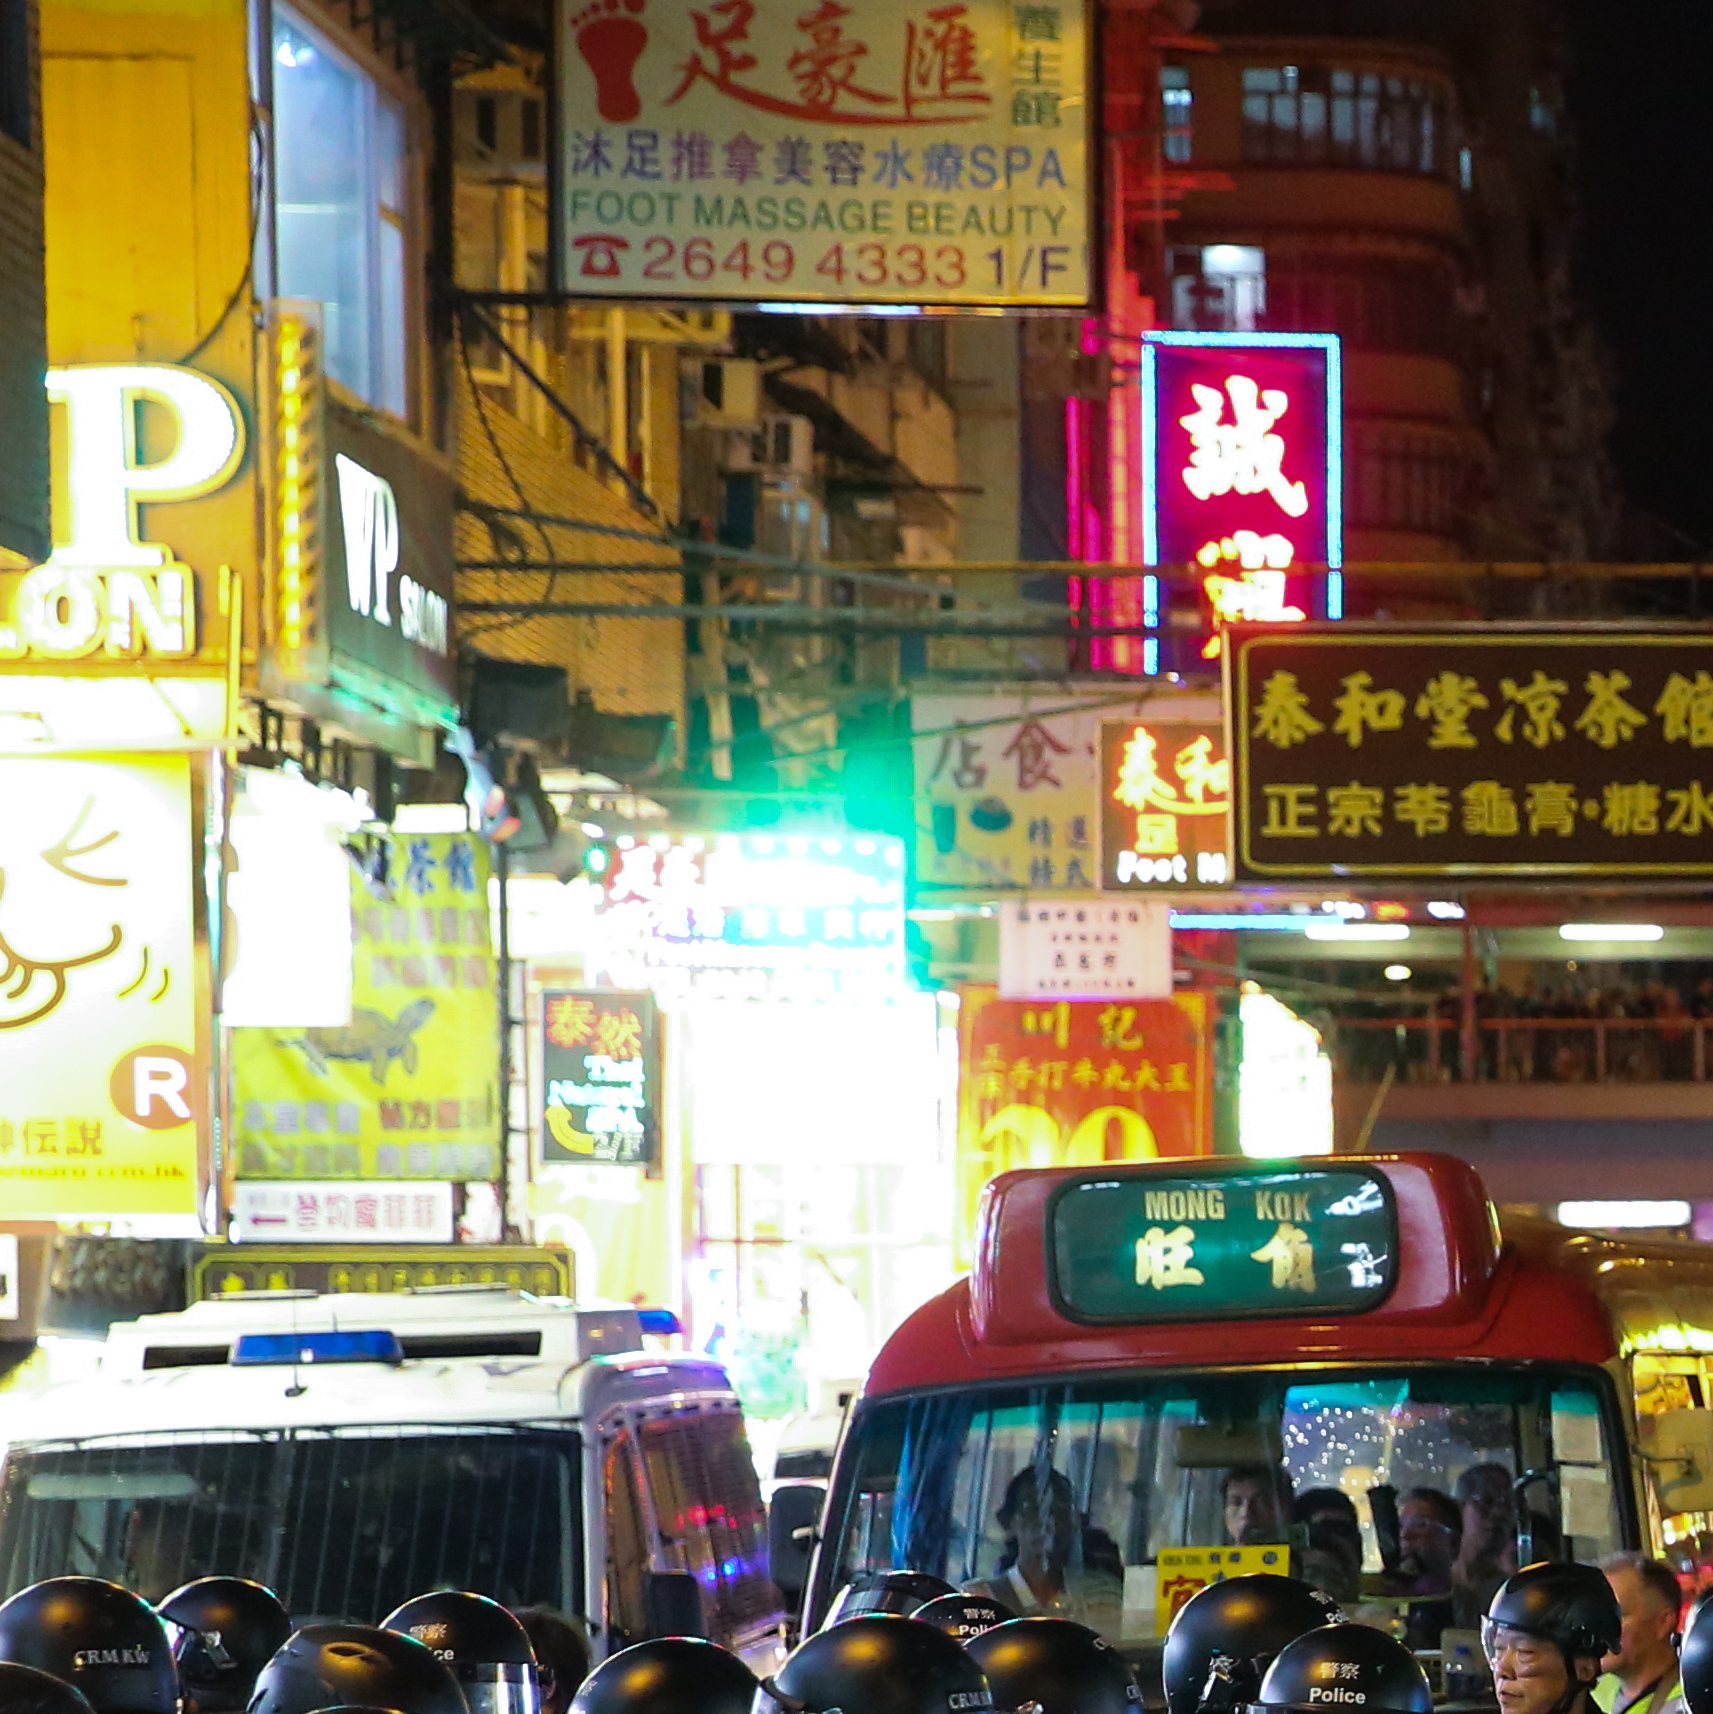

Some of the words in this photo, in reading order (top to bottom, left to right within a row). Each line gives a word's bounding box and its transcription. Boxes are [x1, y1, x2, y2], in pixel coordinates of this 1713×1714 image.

[568, 188, 683, 227] FOOT
[693, 195, 897, 235] MASSAGE
[906, 204, 1068, 238] BEAUTY
[642, 236, 796, 283] 2649
[814, 243, 968, 289] 4333
[987, 246, 1070, 290] 1/F
[0, 563, 195, 660] ON
[1118, 850, 1187, 883] Foot
[1197, 852, 1230, 884] M
[1143, 1189, 1225, 1222] MONG
[1255, 1189, 1313, 1224] KOK
[1132, 1222, 1318, 1294] 旺角
[958, 1624, 990, 1638] Poli
[1320, 1661, 1361, 1681] 警察
[1308, 1687, 1367, 1706] Police
